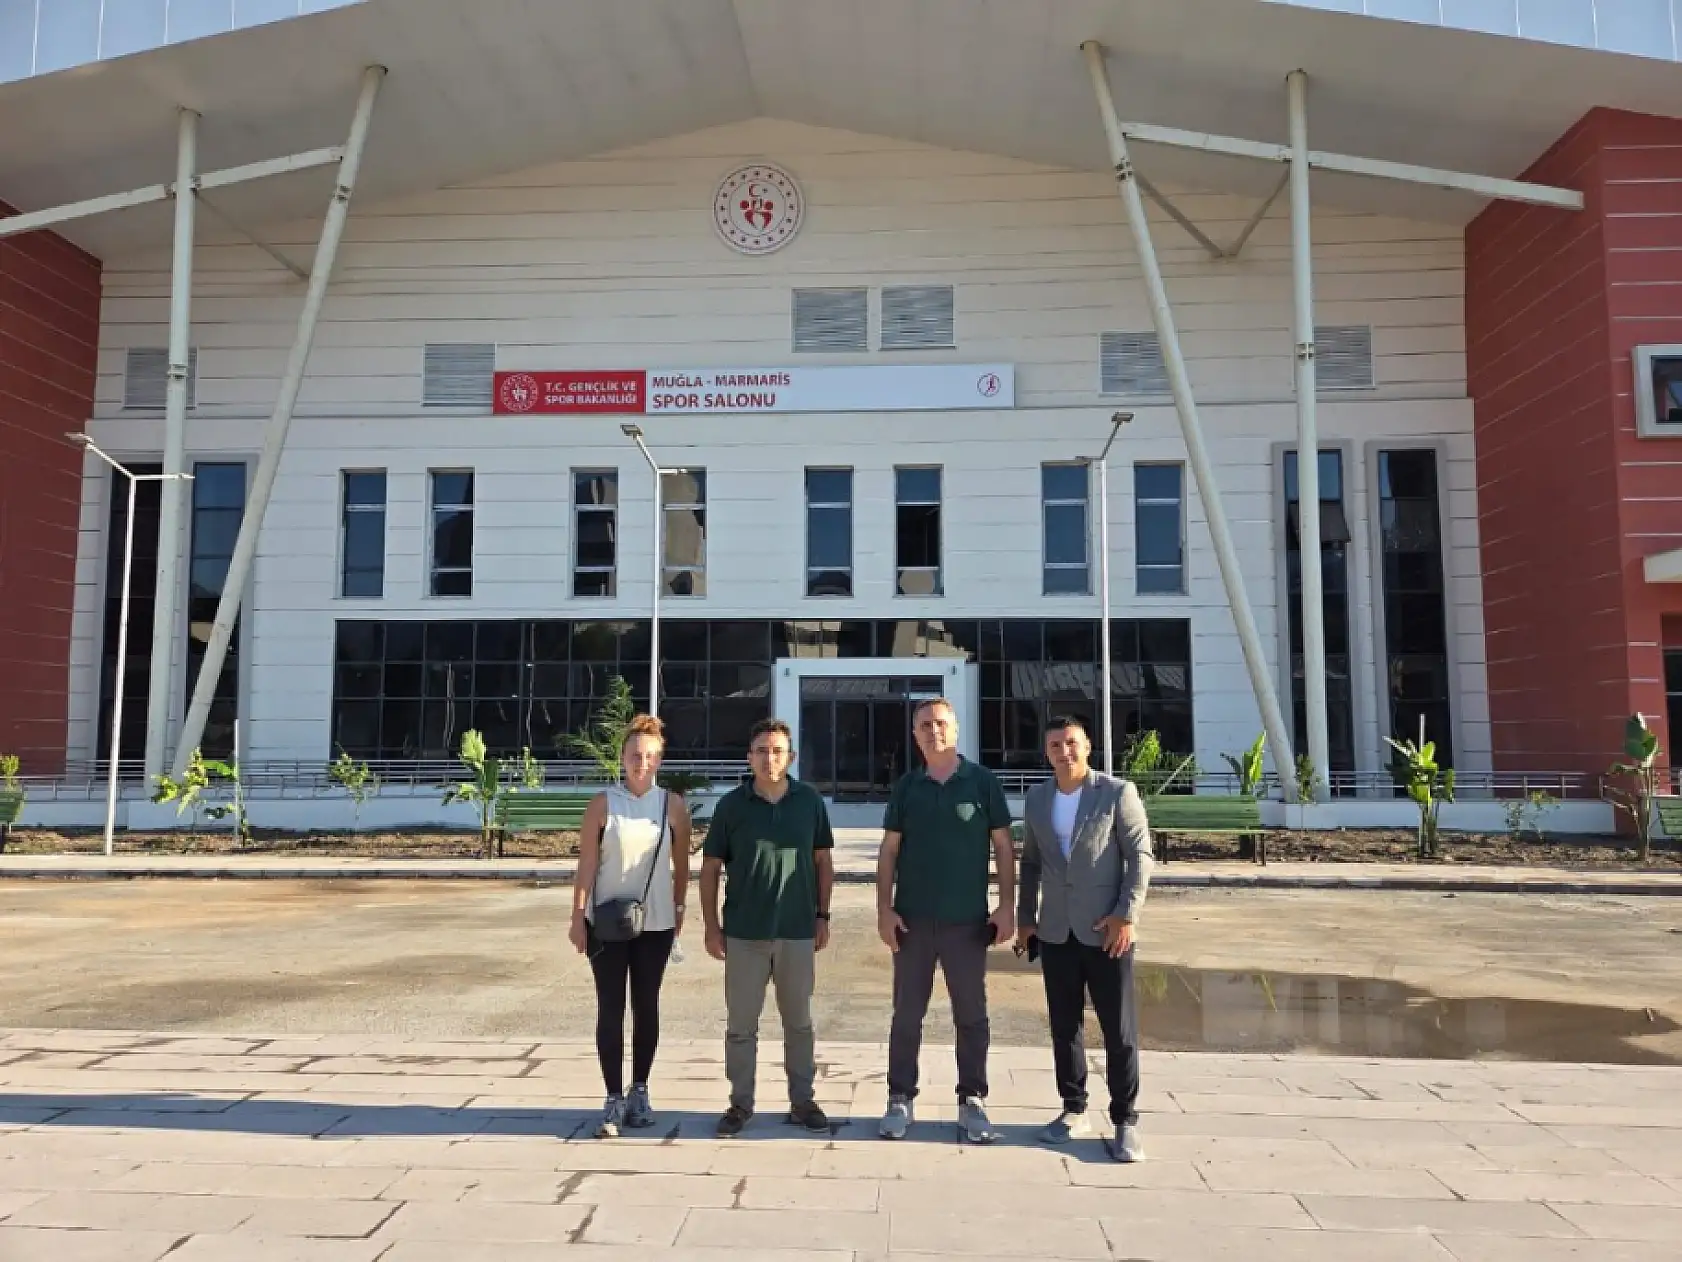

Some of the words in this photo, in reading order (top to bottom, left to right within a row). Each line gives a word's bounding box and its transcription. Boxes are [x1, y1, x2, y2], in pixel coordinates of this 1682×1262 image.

[544, 382, 566, 393] T.C.
[621, 380, 637, 391] VE
[652, 372, 704, 388] MUĞLA
[715, 371, 791, 387] MARMARİS
[544, 394, 575, 405] SPOR
[576, 392, 638, 404] BAKANLIĞI
[652, 393, 700, 409] SPOR
[704, 392, 777, 408] SALONU
